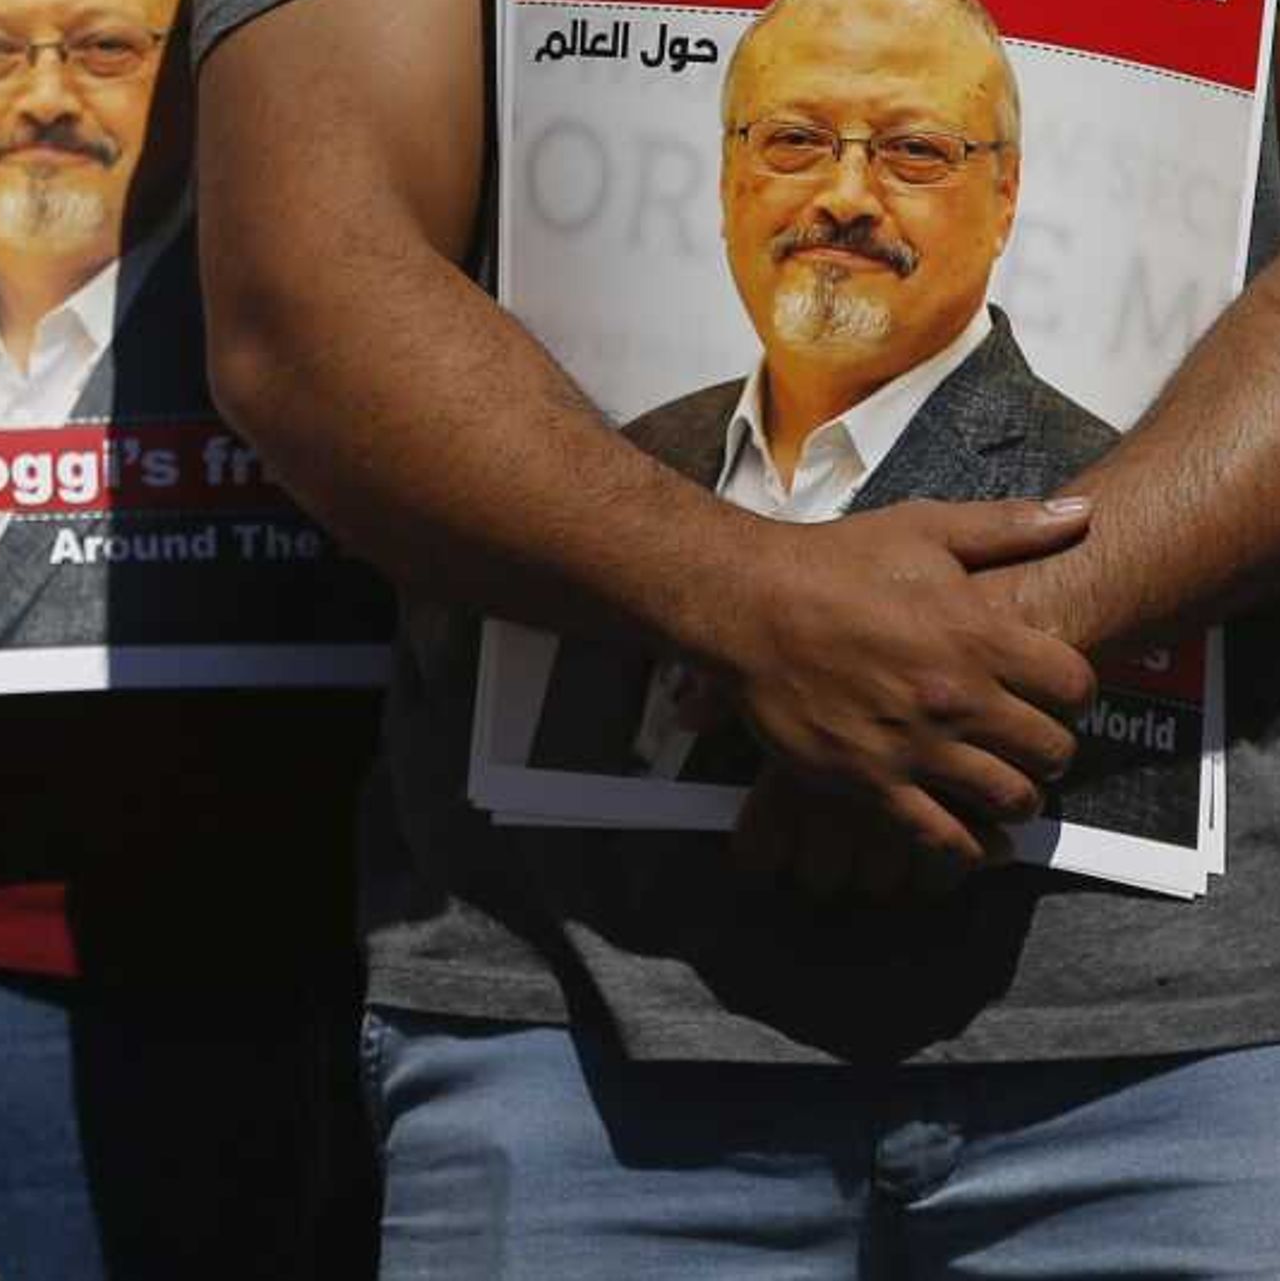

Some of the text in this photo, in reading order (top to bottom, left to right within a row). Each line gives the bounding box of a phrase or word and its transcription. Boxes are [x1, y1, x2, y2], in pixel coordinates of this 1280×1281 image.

[534, 18, 718, 72] حول العالم
[49, 524, 320, 564] Around The
